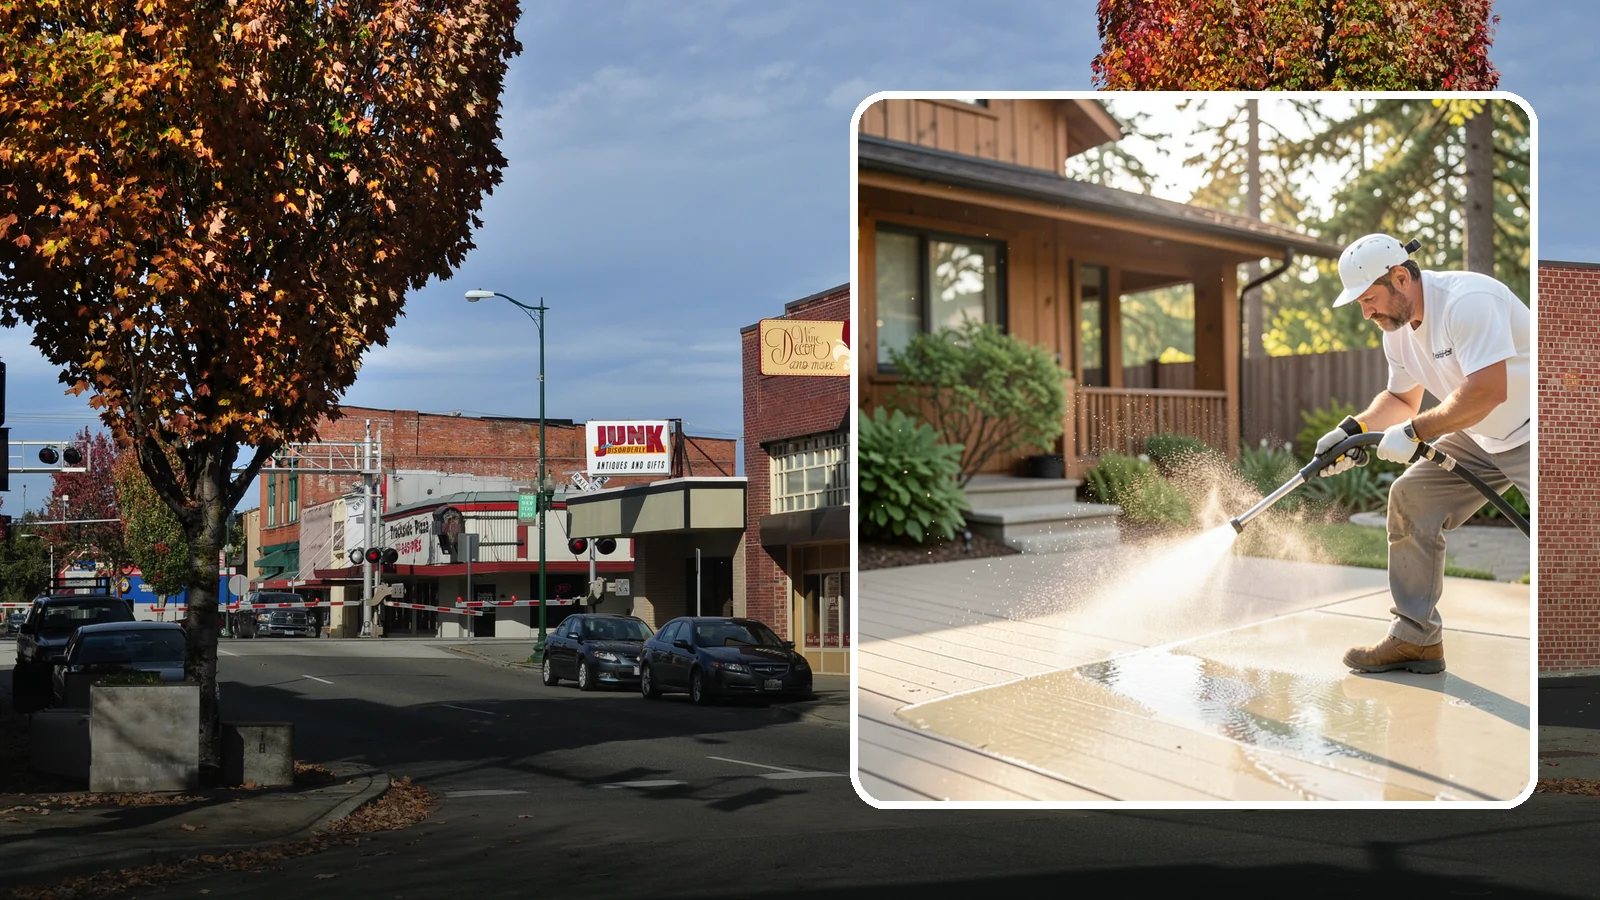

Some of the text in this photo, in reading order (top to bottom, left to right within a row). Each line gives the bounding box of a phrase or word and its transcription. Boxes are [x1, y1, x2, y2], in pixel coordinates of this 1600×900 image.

[764, 327, 831, 366] Decor
[595, 425, 665, 457] JUNK
[607, 446, 646, 454] DISORDERLY
[597, 460, 665, 470] ANTIQUES AND GIFTS
[414, 519, 429, 535] Pizza
